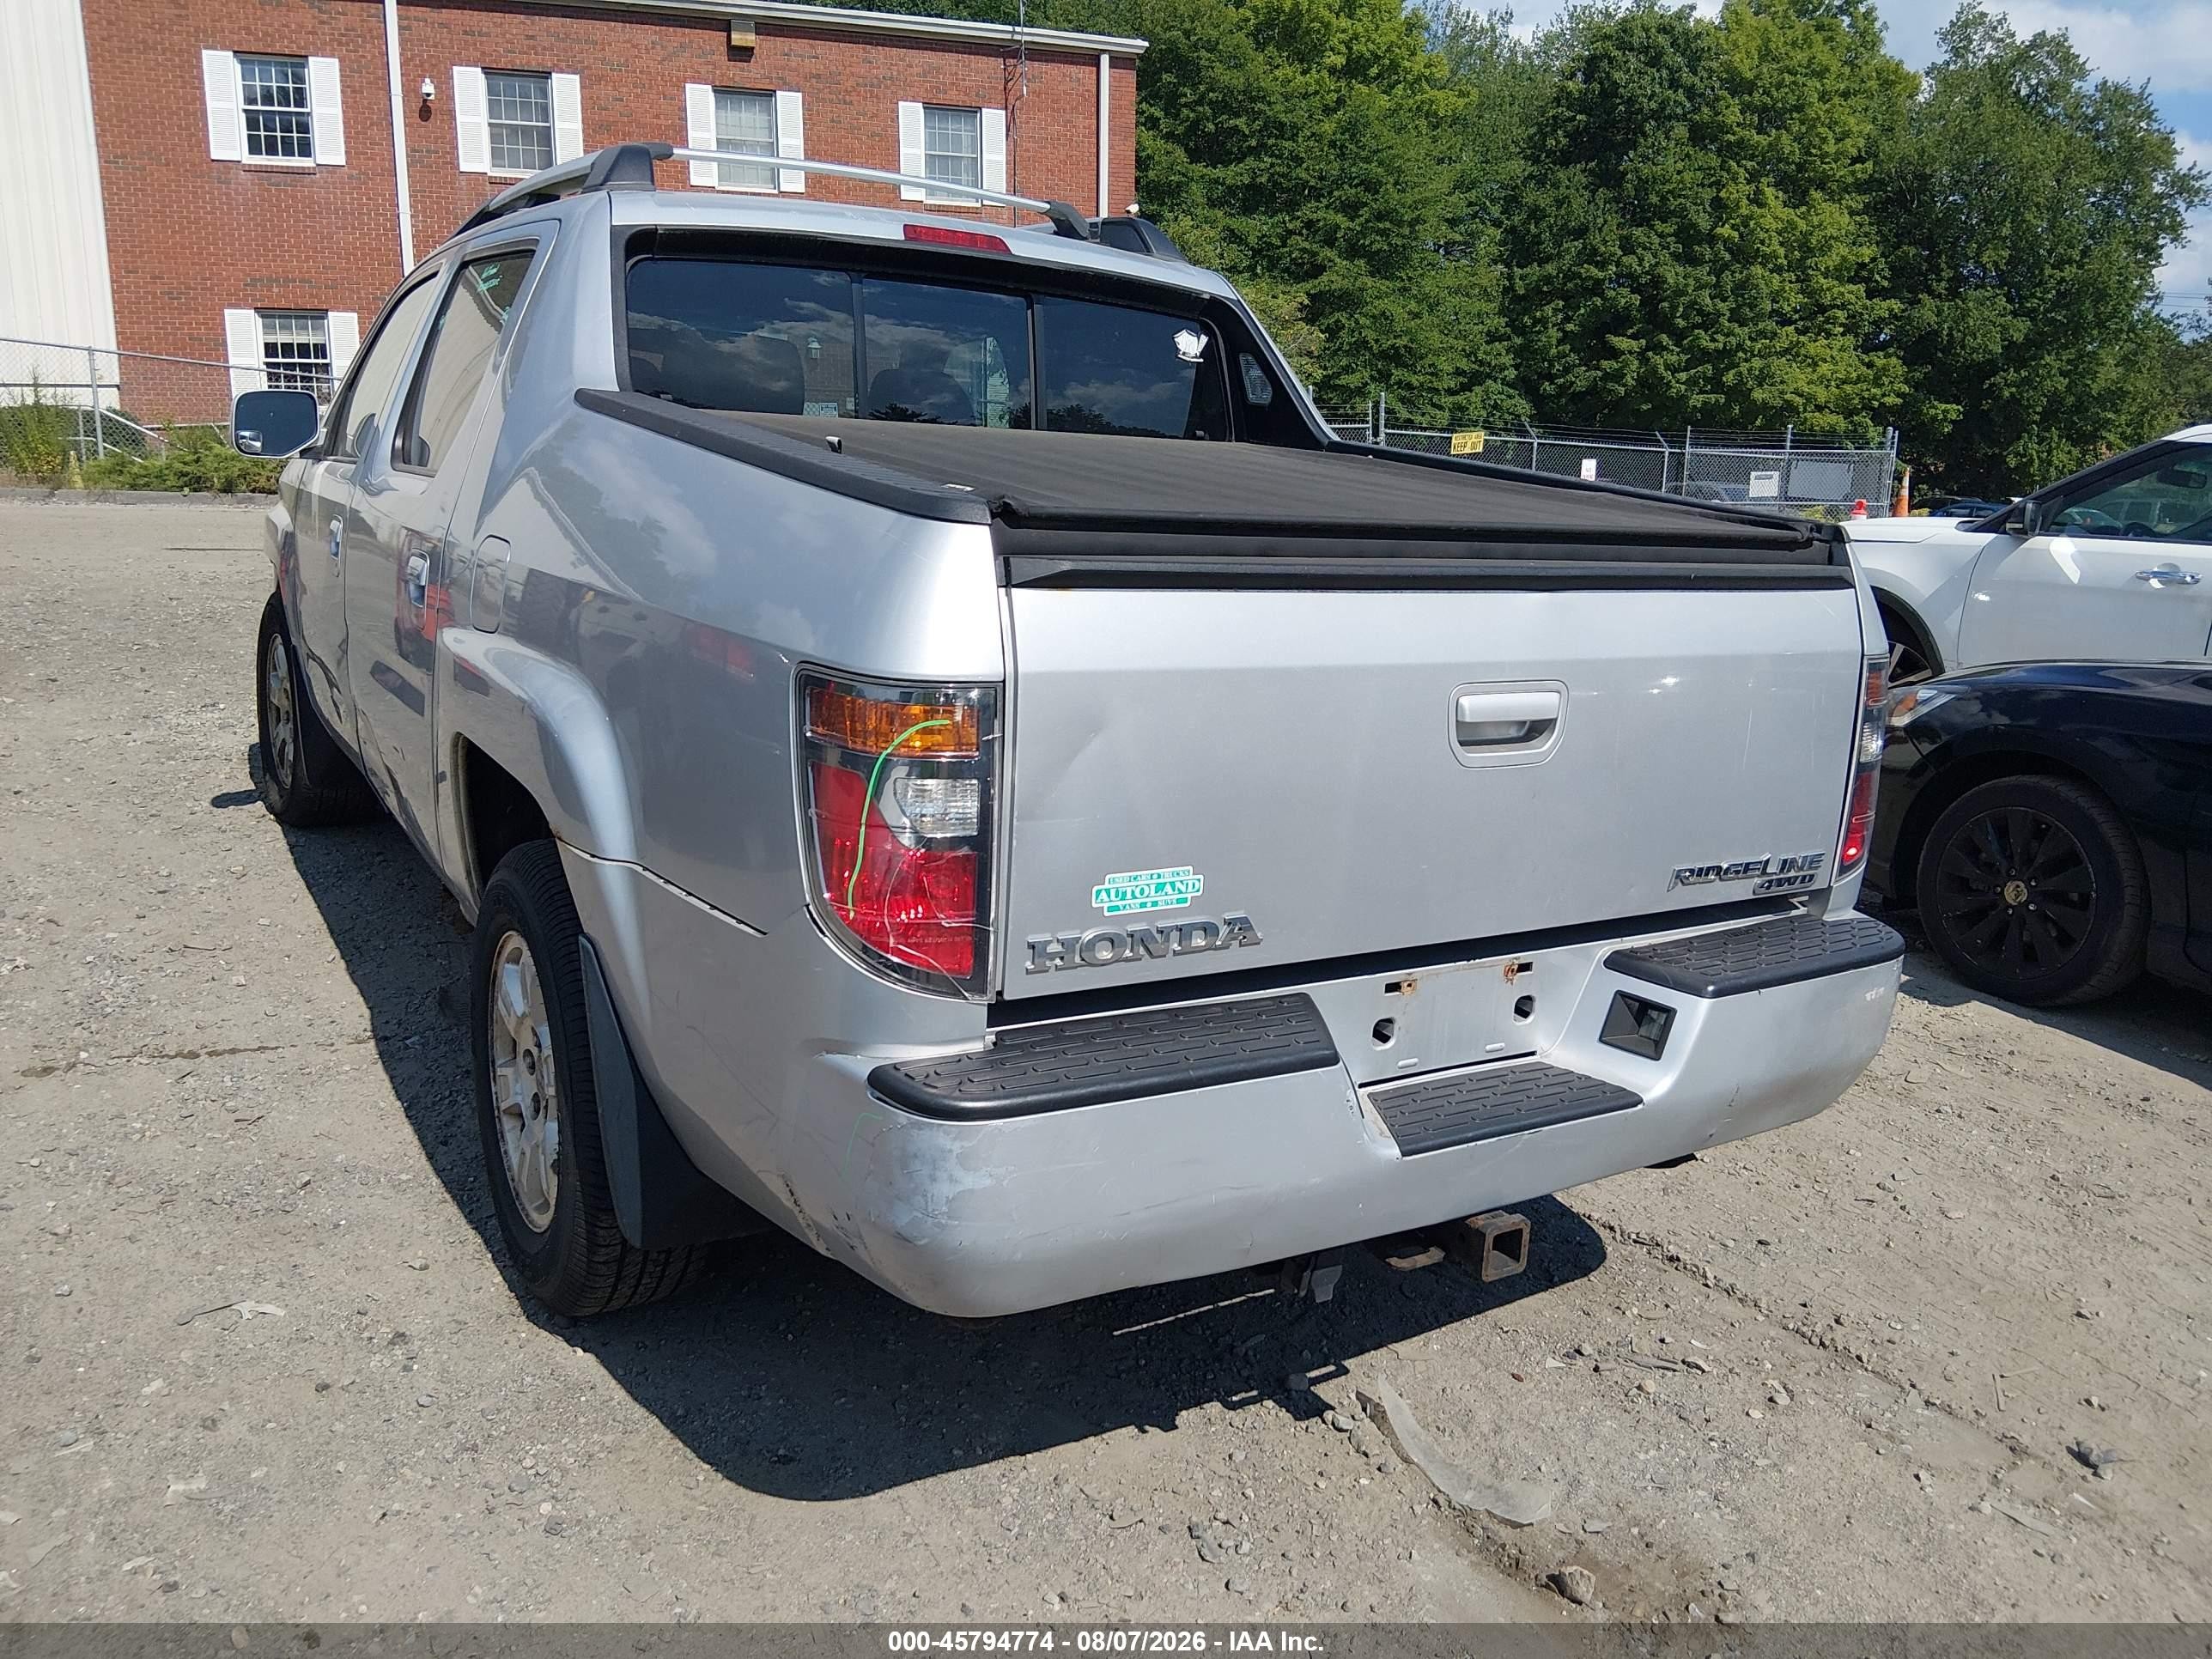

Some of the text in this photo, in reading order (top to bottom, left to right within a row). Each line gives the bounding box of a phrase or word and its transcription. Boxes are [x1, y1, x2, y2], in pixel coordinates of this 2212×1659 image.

[1452, 440, 1482, 453] KEEP OUT
[1131, 873, 1151, 883] CARS
[1160, 869, 1190, 879] TRUCKS
[1667, 852, 1826, 892] RIDGELINE
[1095, 878, 1200, 903] AUTOLAND
[1757, 873, 1815, 892] 4WD
[1119, 901, 1140, 911] VANS
[1024, 910, 1264, 975] HONDA
